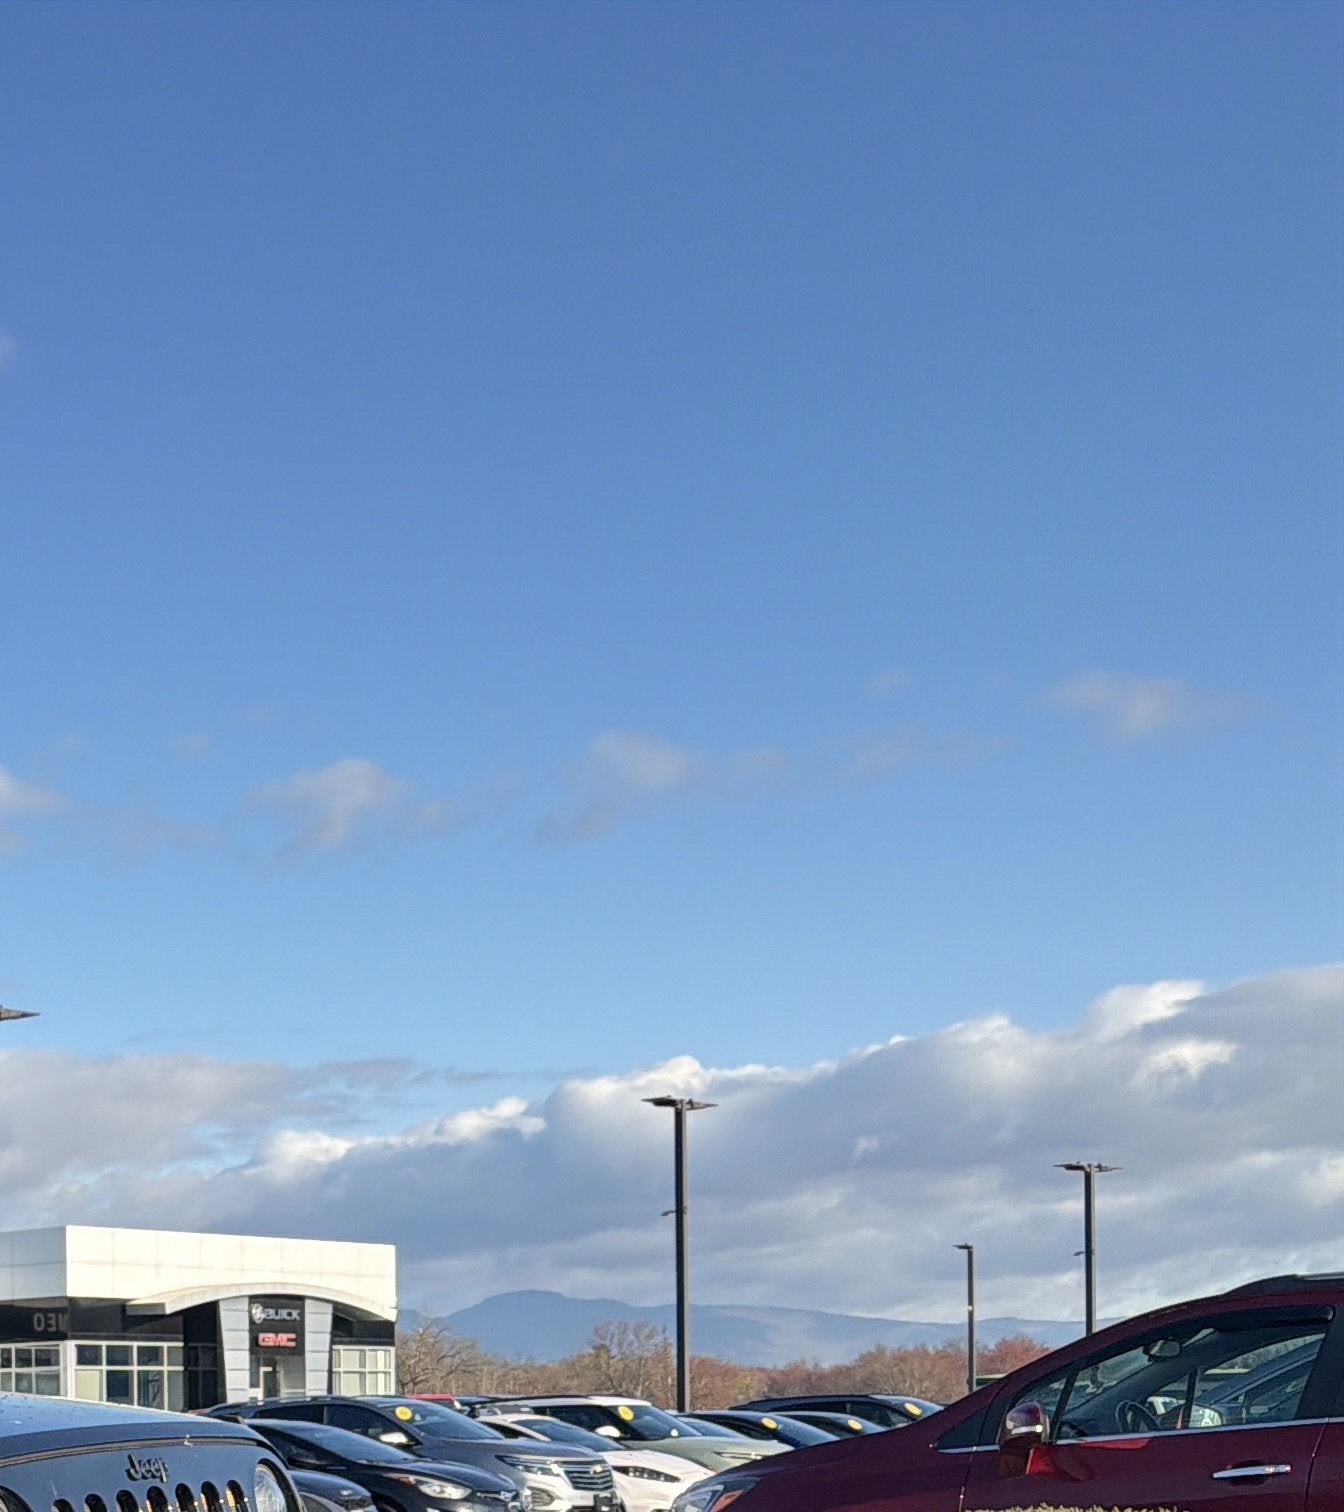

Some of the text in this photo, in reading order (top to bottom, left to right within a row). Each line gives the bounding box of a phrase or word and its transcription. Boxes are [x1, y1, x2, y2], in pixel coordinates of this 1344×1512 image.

[263, 1308, 301, 1321] BUICK
[258, 1332, 297, 1348] GMC
[125, 1454, 169, 1484] Jeep
